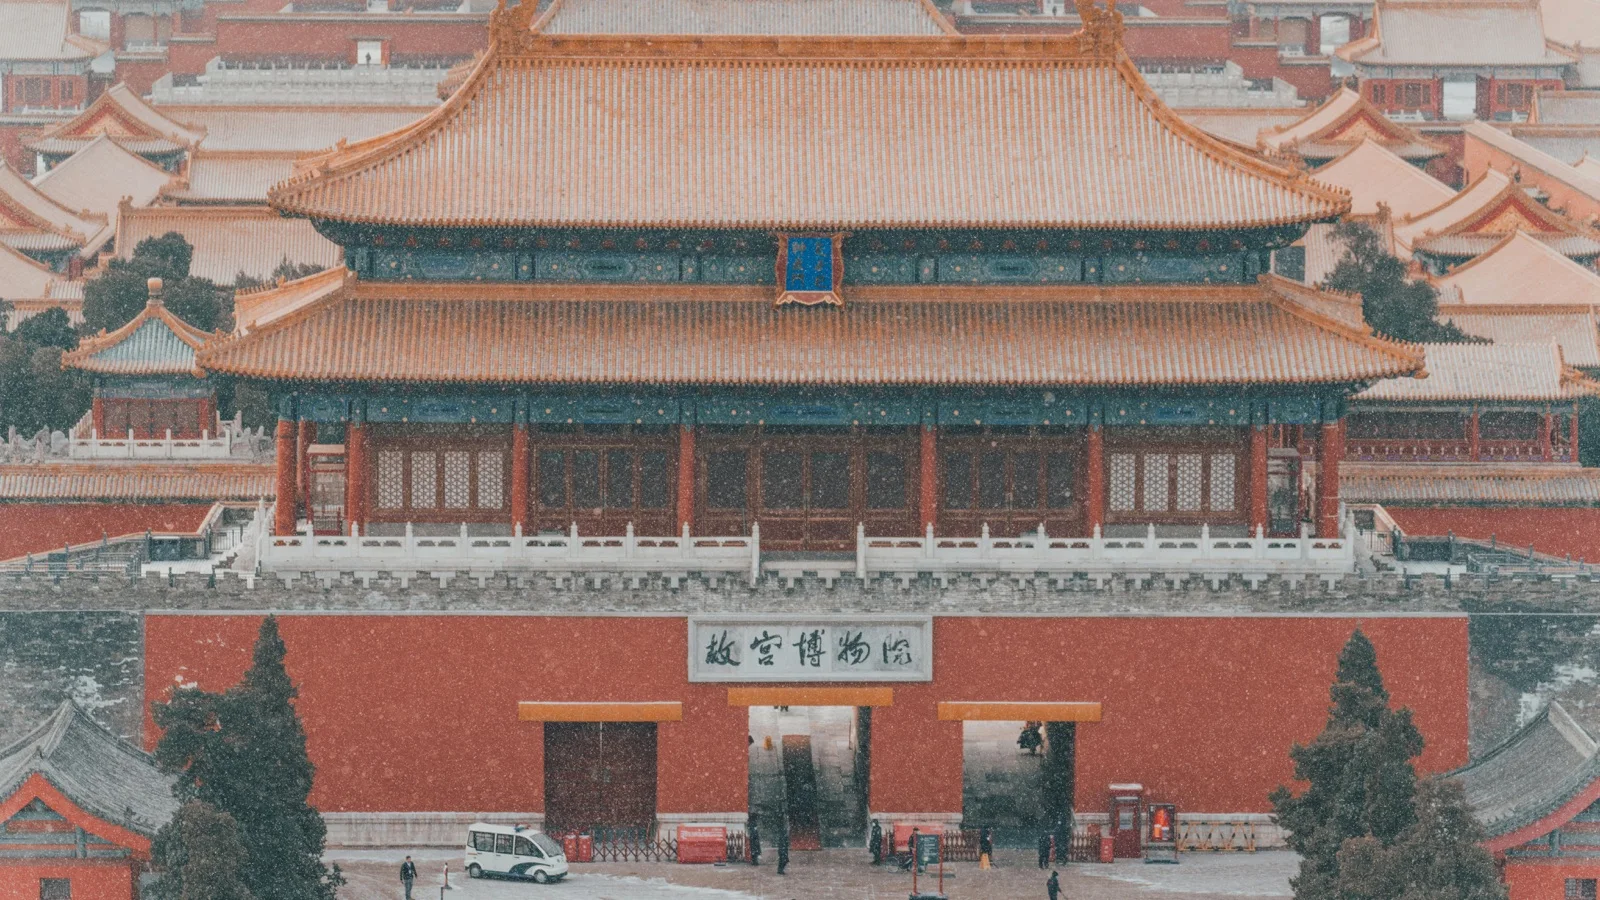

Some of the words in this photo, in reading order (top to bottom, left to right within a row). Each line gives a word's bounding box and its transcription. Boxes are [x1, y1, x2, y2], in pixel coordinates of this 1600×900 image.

[705, 629, 913, 667] 故宫博物院
